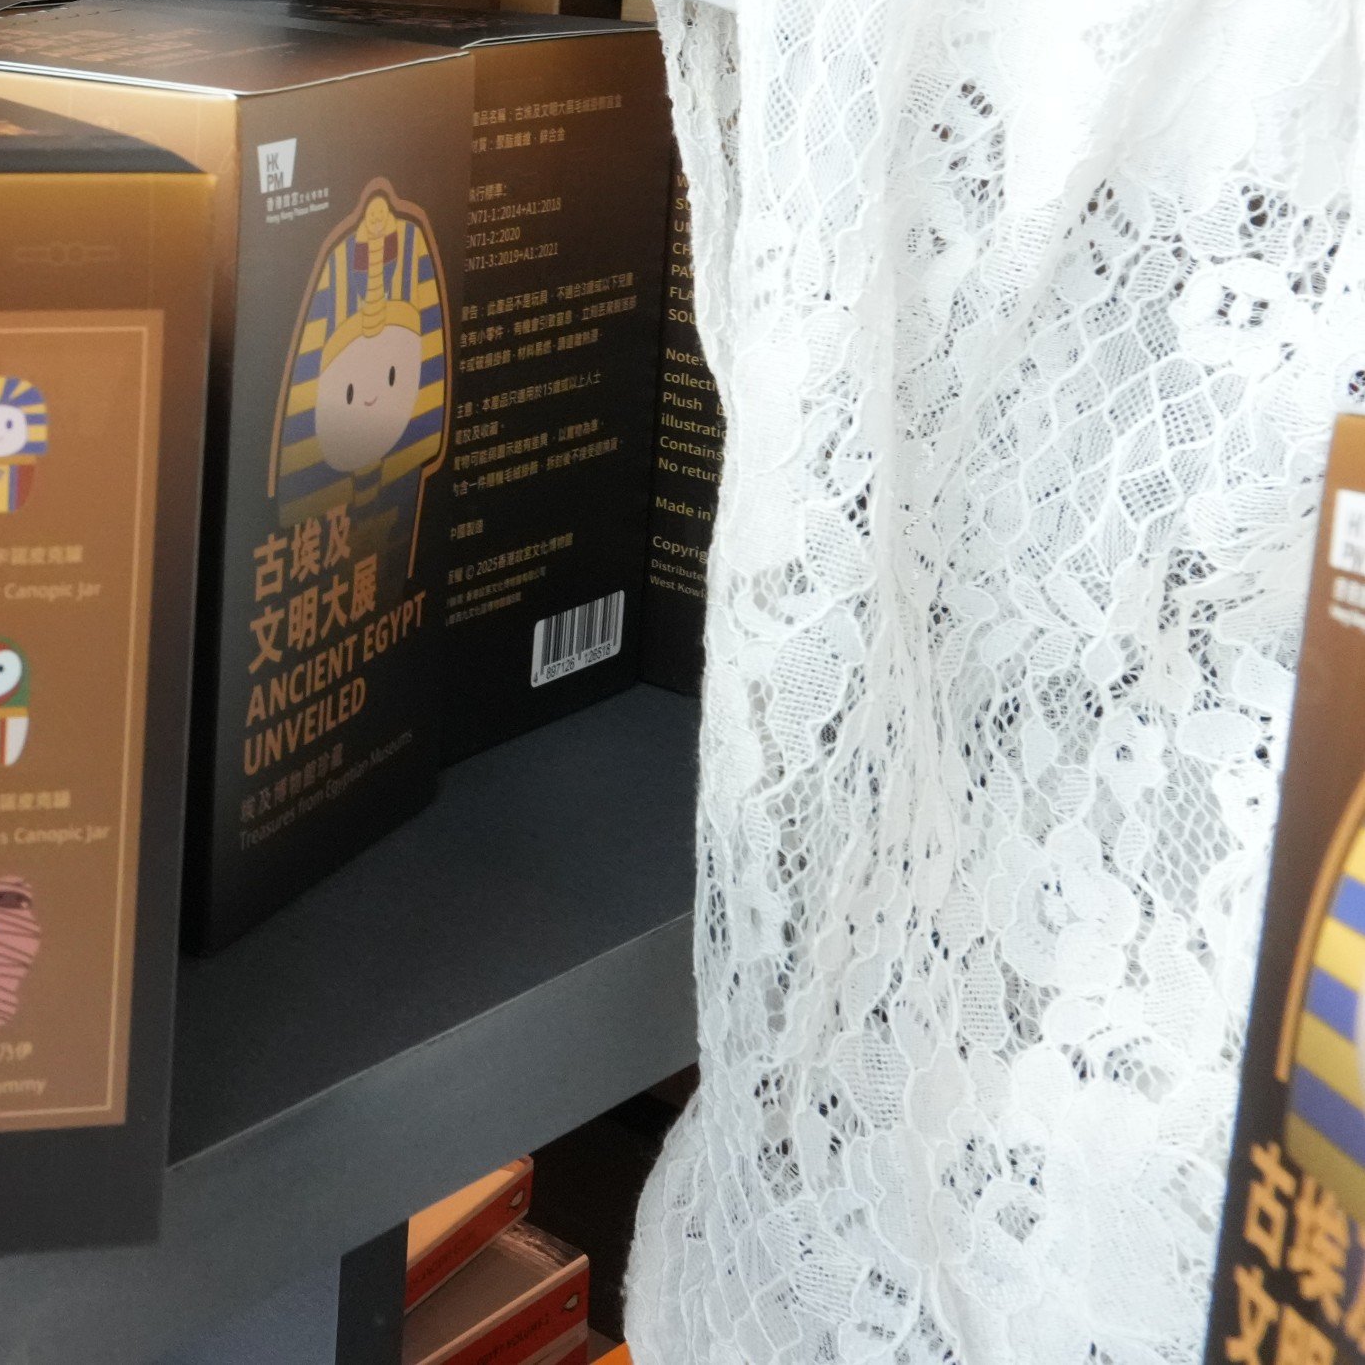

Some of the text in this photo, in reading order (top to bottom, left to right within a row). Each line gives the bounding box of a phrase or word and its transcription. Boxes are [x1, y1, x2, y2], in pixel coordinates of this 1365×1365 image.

[664, 347, 704, 368] Note:
[254, 503, 351, 602] 古埃及
[246, 634, 358, 728] ANCIENT
[363, 591, 426, 663] EGYPT
[249, 554, 378, 674] 文明大展
[244, 677, 366, 777] UNVEILED
[1243, 1140, 1365, 1351] 古埃
